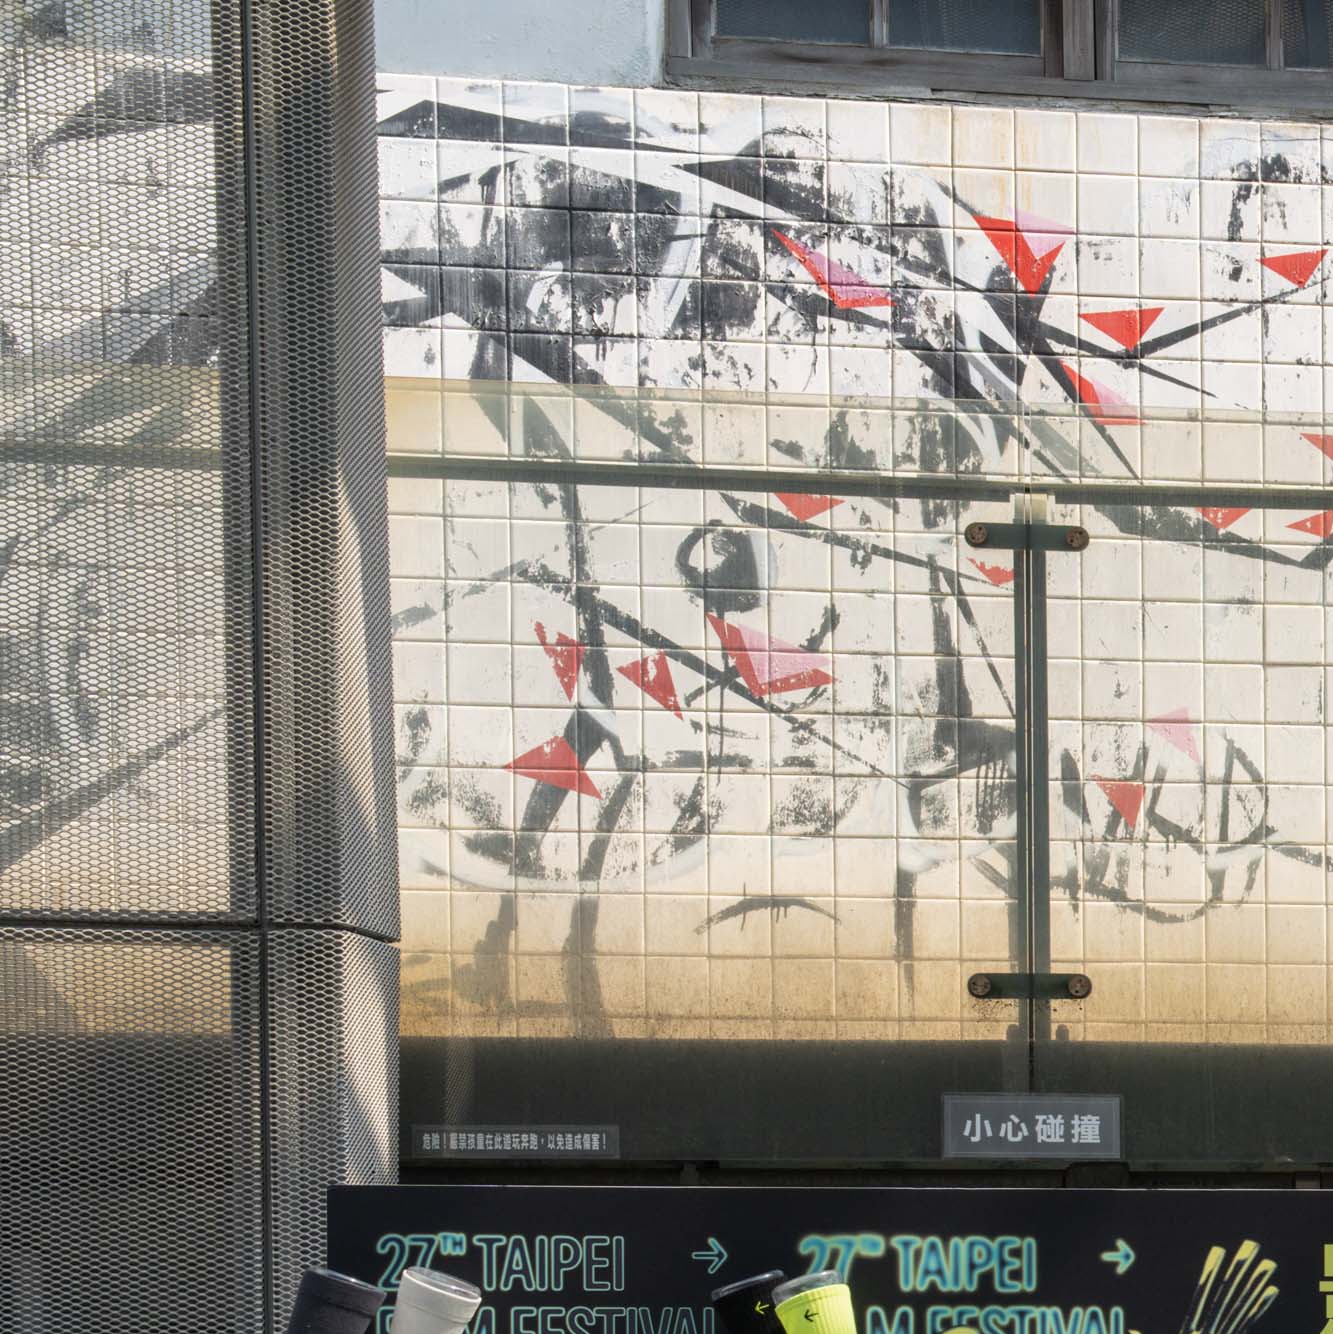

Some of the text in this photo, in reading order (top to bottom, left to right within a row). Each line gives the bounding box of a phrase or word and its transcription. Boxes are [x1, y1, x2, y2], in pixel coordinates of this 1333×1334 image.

[963, 1113, 1102, 1145] 小心碰撞
[473, 1235, 625, 1292] TAIPEI
[891, 1235, 1037, 1293] TAIPEI
